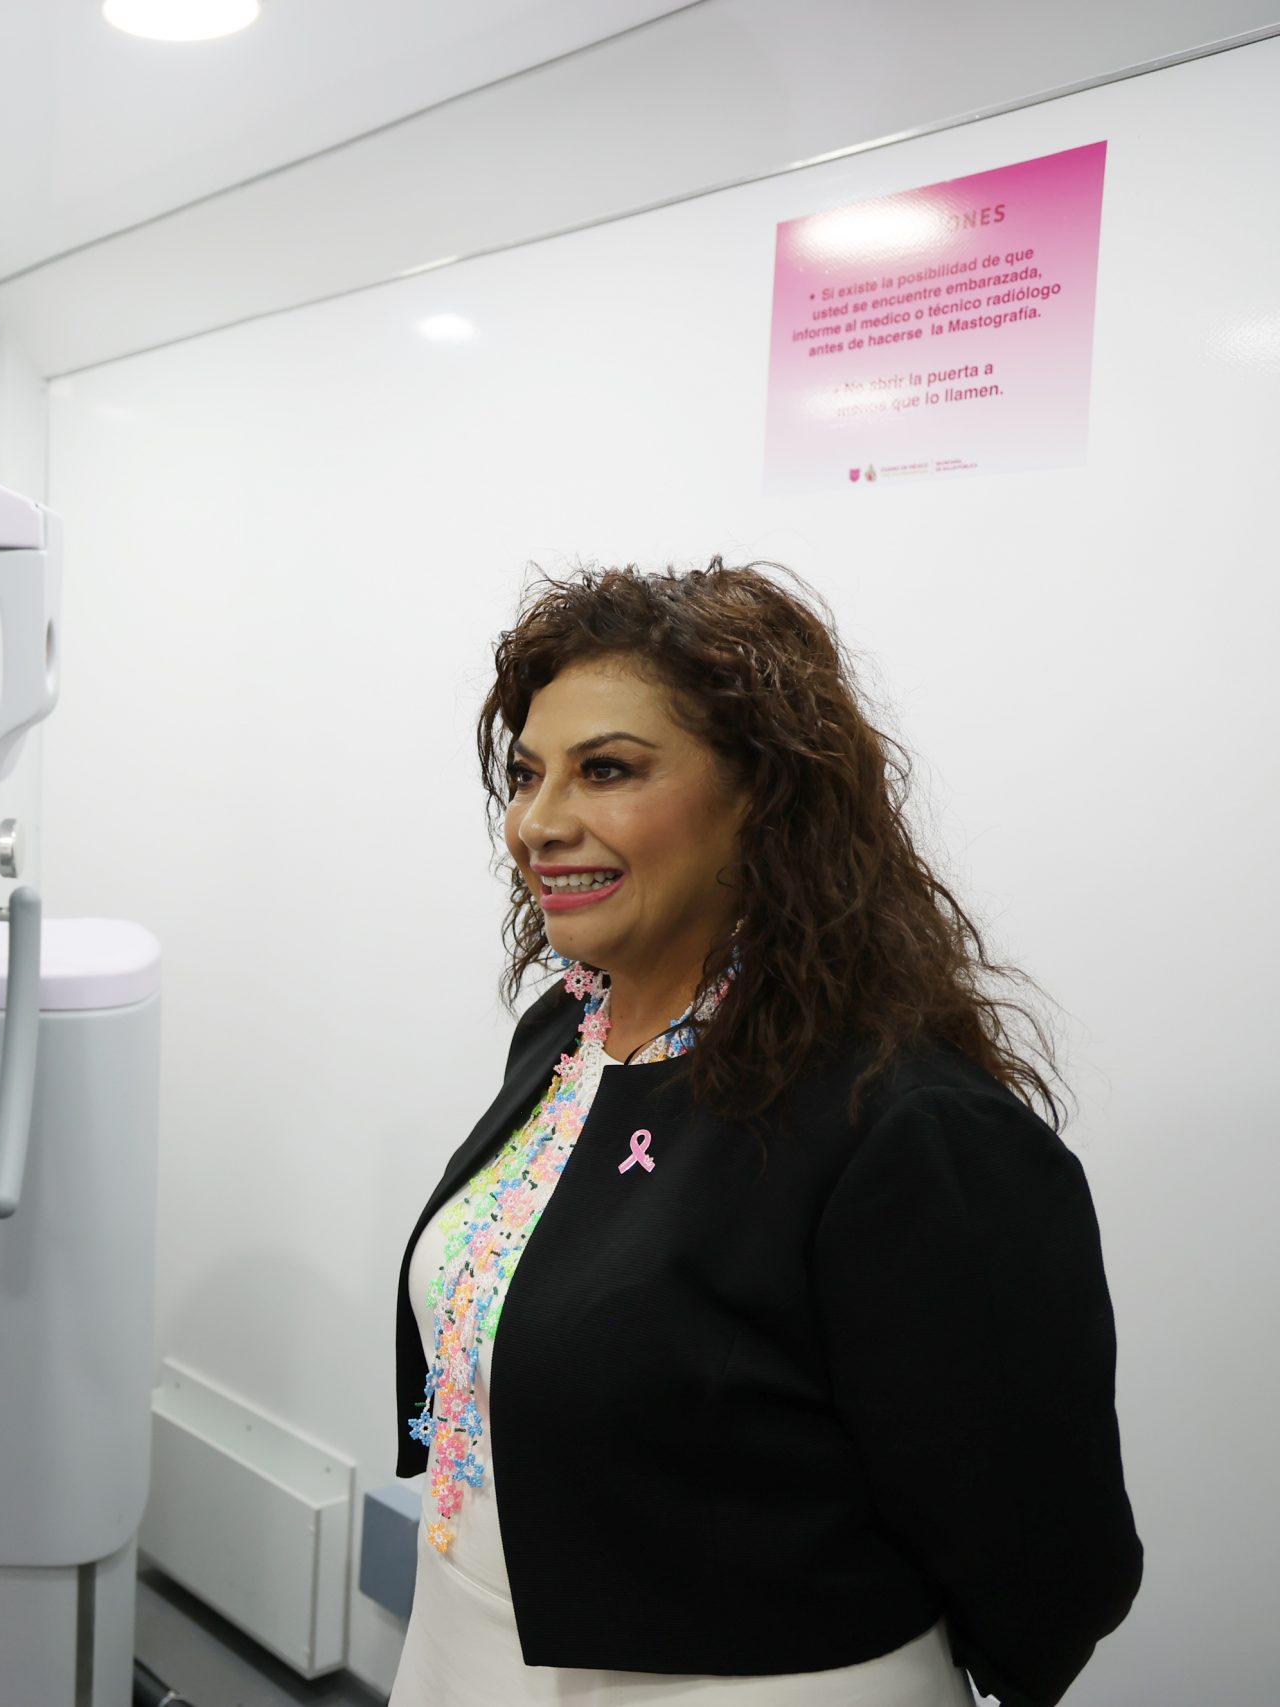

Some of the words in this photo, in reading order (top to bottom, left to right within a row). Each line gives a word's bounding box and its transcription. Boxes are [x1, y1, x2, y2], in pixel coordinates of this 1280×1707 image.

[812, 303, 849, 321] usted
[852, 301, 868, 313] se
[871, 287, 942, 309] encuentre
[945, 266, 1042, 295] embarazada,
[821, 287, 835, 302] Si
[837, 281, 878, 298] existe
[881, 277, 894, 289] la
[897, 258, 977, 289] posibilidad
[982, 254, 1000, 269] de
[1005, 248, 1034, 267] que
[791, 324, 842, 343] informe
[844, 318, 857, 333] al
[914, 308, 924, 320] o
[928, 298, 982, 318] técnico
[986, 283, 1062, 306] radiólogo
[808, 342, 844, 357] antes
[847, 337, 865, 351] de
[867, 328, 923, 347] hacerse
[930, 323, 944, 336] la
[948, 306, 1042, 333] Mastografía.
[891, 396, 921, 412] que
[925, 391, 940, 405] lo
[944, 383, 1004, 403] llamen.
[908, 371, 923, 386] la
[927, 364, 979, 388] puerta
[984, 362, 994, 376] a
